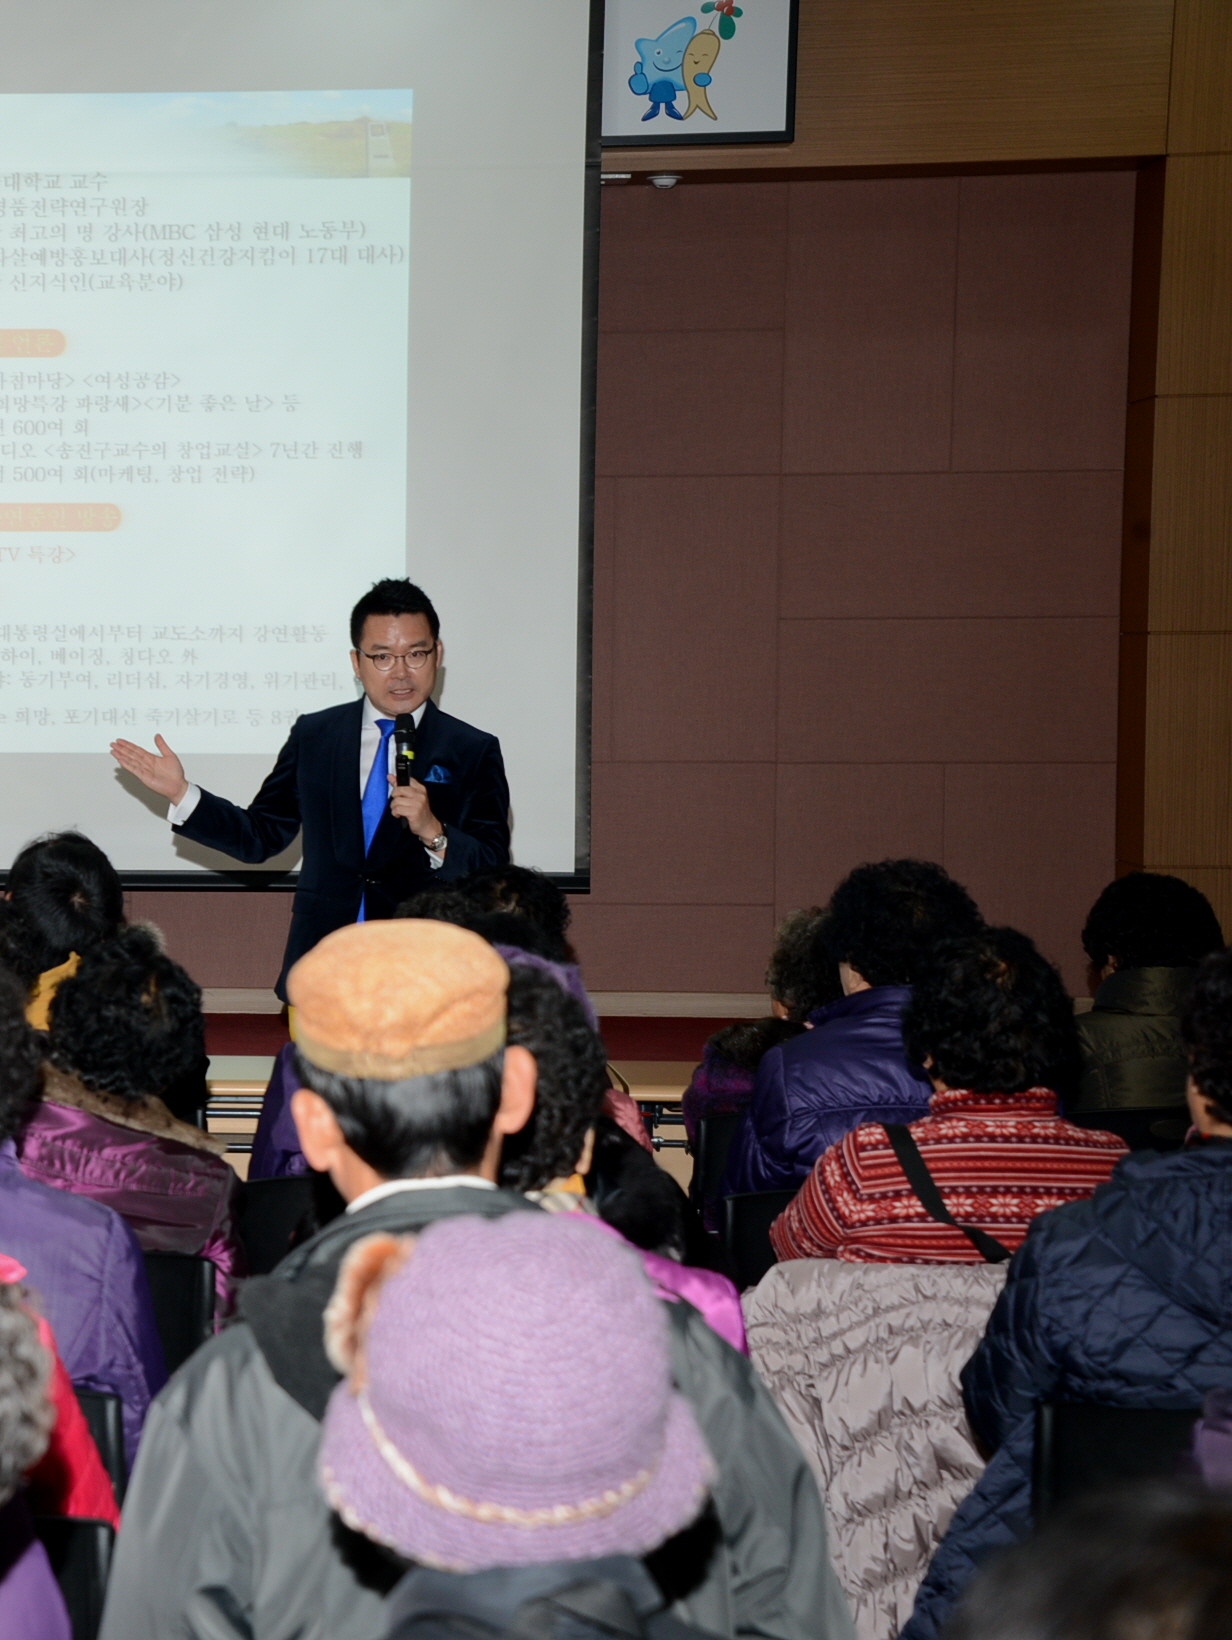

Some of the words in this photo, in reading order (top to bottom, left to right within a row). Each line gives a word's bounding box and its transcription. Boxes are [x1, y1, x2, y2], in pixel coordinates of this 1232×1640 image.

[69, 171, 109, 192] 교수
[9, 223, 66, 243] 최고의
[76, 223, 94, 243] 명
[104, 221, 196, 243] 강사(MBC
[204, 221, 243, 242] 삼성
[253, 221, 290, 241] 현대
[299, 221, 367, 241] 노동부)
[307, 244, 348, 265] 17대
[358, 244, 405, 265] 대사)
[9, 272, 183, 293] 신지식인(교육분야)
[82, 371, 181, 390] <여성공감>
[200, 394, 237, 413] 좋은
[245, 394, 274, 412] 날>
[281, 394, 301, 412] 등
[13, 418, 64, 436] 600여
[73, 418, 89, 436] 회
[44, 442, 167, 460] <송진구교수의
[178, 441, 263, 461] 창업교실>
[269, 441, 319, 460] 7년간
[328, 441, 365, 460] 진행
[13, 466, 64, 483] 500여
[168, 465, 202, 484] 창업
[212, 465, 256, 484] 전략)
[77, 507, 118, 528] 방송
[27, 546, 77, 564] 특강>
[152, 624, 244, 643] 교도소까지
[253, 625, 328, 643] 강연활동
[51, 647, 111, 666] 베이징,
[119, 647, 173, 666] 칭다오
[19, 671, 99, 689] 동기부여,
[107, 671, 167, 689] 리더십,
[176, 671, 255, 690] 자기경영,
[263, 671, 344, 691] 위기관리,
[14, 707, 55, 726] 희망,
[63, 707, 137, 726] 포기대신
[146, 708, 239, 726] 죽기살기로
[246, 708, 263, 727] 등
